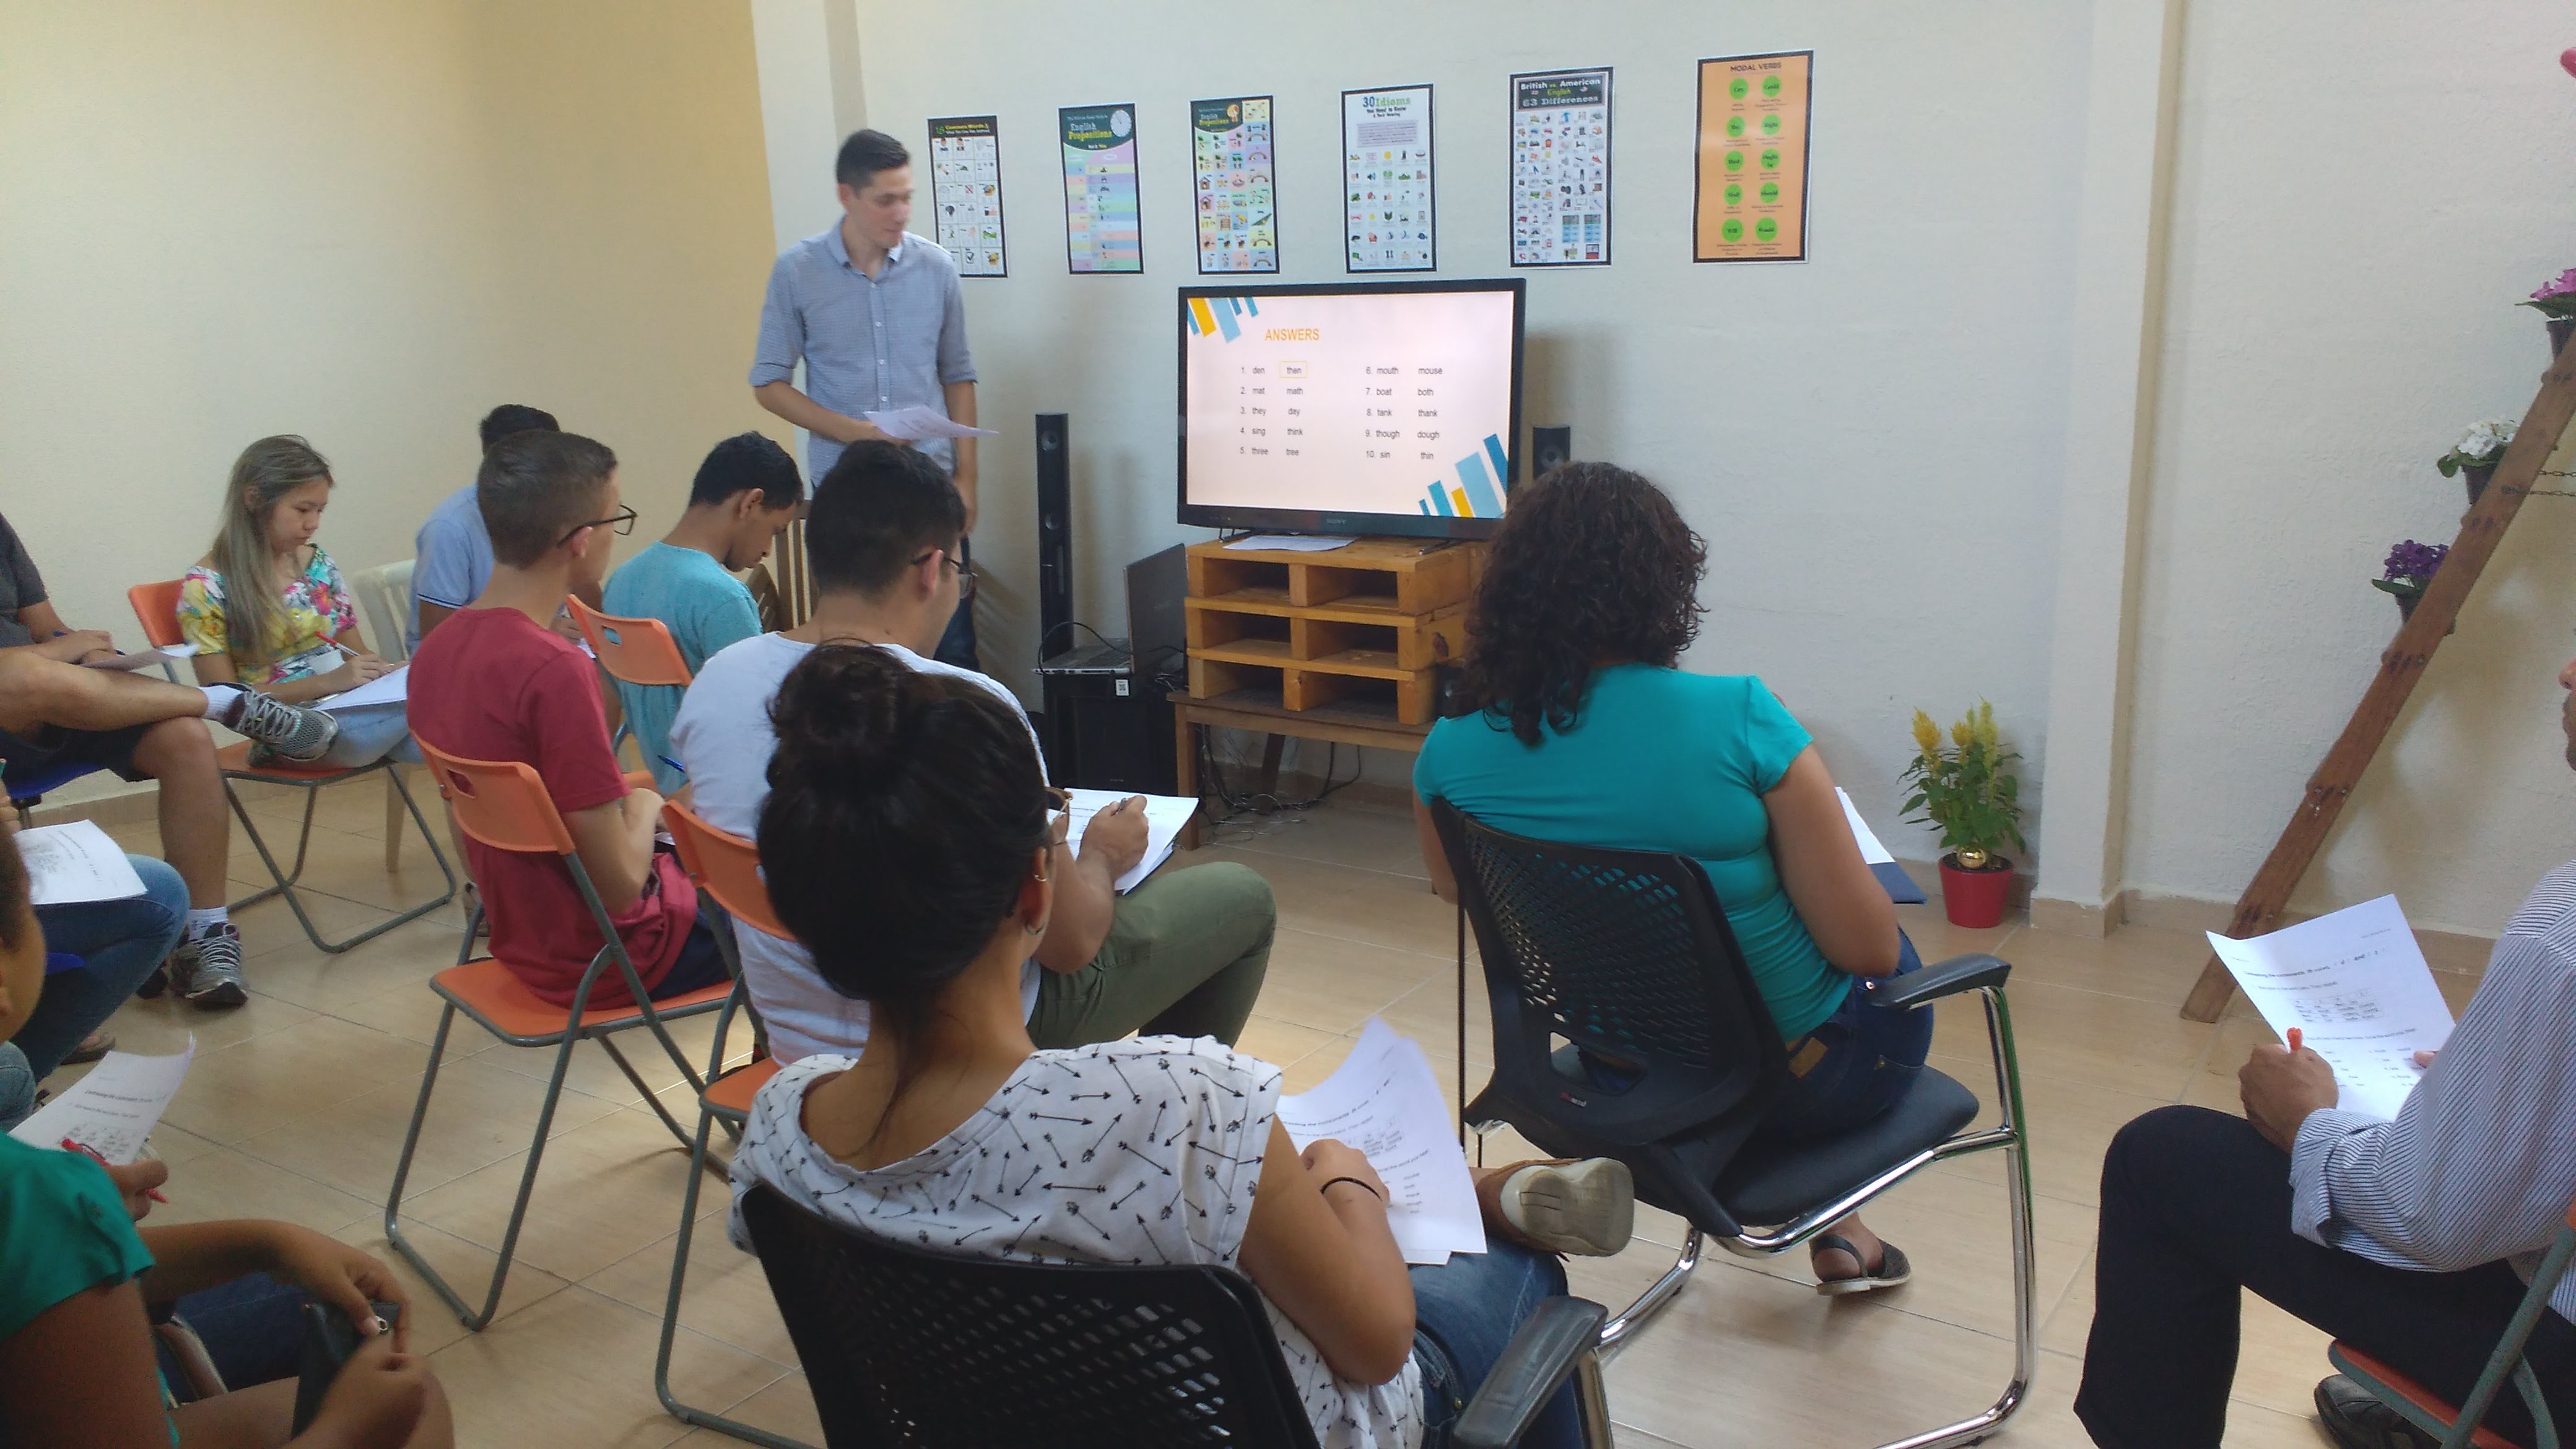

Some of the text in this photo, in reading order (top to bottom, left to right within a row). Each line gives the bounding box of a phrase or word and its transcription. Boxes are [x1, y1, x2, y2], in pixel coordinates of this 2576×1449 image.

[1759, 62, 1782, 70] VERBS
[1521, 82, 1548, 90] British
[1559, 79, 1601, 88] American
[1376, 97, 1411, 107] Idioms
[1541, 95, 1599, 105] Differences
[1265, 328, 1320, 341] ANSWERS
[1252, 367, 1265, 375] den
[1287, 367, 1302, 375] then
[1377, 367, 1399, 375] mouth
[1287, 387, 1303, 395] math
[1417, 388, 1434, 396] both
[1252, 407, 1266, 416] they
[1288, 408, 1300, 417] day
[1252, 429, 1266, 437] sing
[1376, 430, 1400, 440] though
[1417, 431, 1440, 440] dough
[1421, 451, 1434, 459] thin
